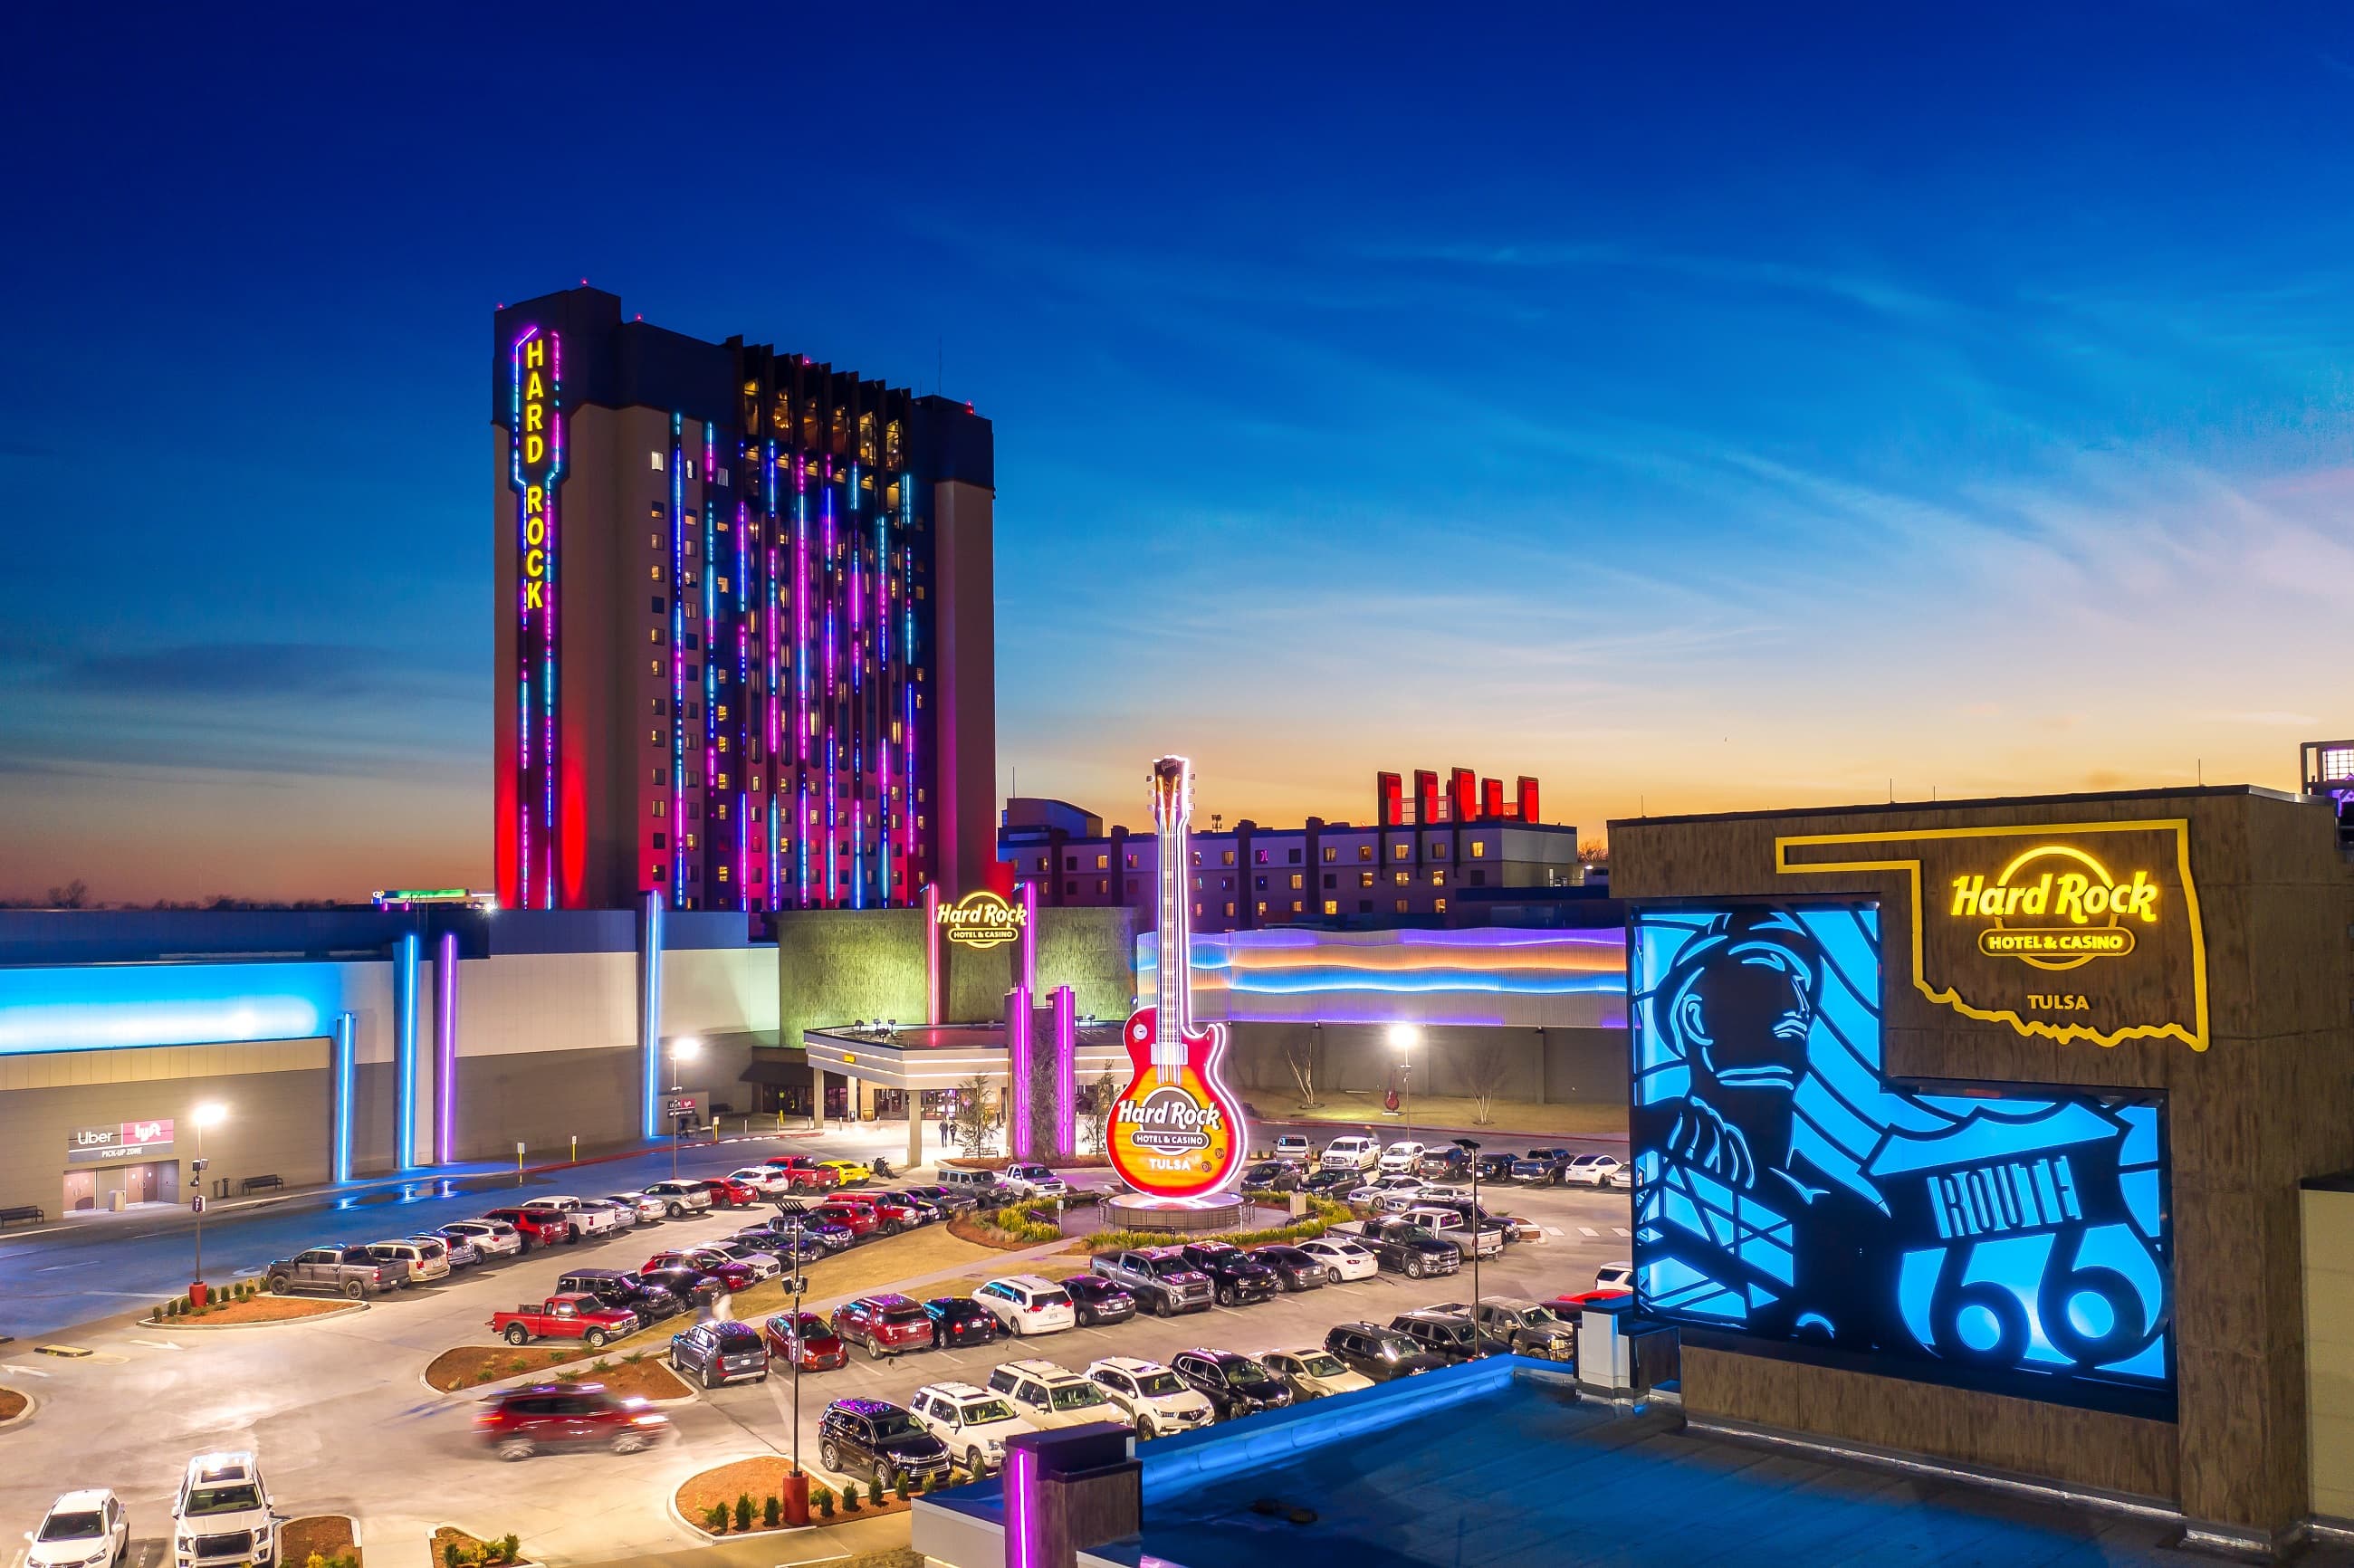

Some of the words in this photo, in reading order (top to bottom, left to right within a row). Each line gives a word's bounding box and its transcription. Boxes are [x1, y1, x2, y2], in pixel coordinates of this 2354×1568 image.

[526, 339, 543, 464] HARD
[527, 486, 544, 609] ROCK
[1951, 873, 2053, 916] Hard
[2055, 871, 2158, 924] Rock
[936, 904, 983, 923] Hard
[984, 903, 1028, 926] Rock
[953, 931, 978, 939] HOTEL
[985, 930, 1013, 938] CASINO
[1989, 936, 2043, 950] HOTEL
[2043, 936, 2057, 950] &
[2059, 935, 2123, 950] CASINO
[2027, 994, 2090, 1011] TULSA
[1117, 1100, 1169, 1123] Hard
[1171, 1101, 1220, 1130] Rock
[78, 1131, 113, 1144] Uber
[134, 1122, 161, 1142] lyft
[1136, 1134, 1163, 1143] HOTEL
[1163, 1135, 1171, 1143] &
[1171, 1136, 1203, 1145] CASINO
[101, 1149, 127, 1158] PICK-UP
[127, 1147, 143, 1155] ZONE
[1149, 1158, 1191, 1171] TULSA
[1928, 1155, 2081, 1238] ROUTE
[1927, 1222, 2151, 1365] 66
